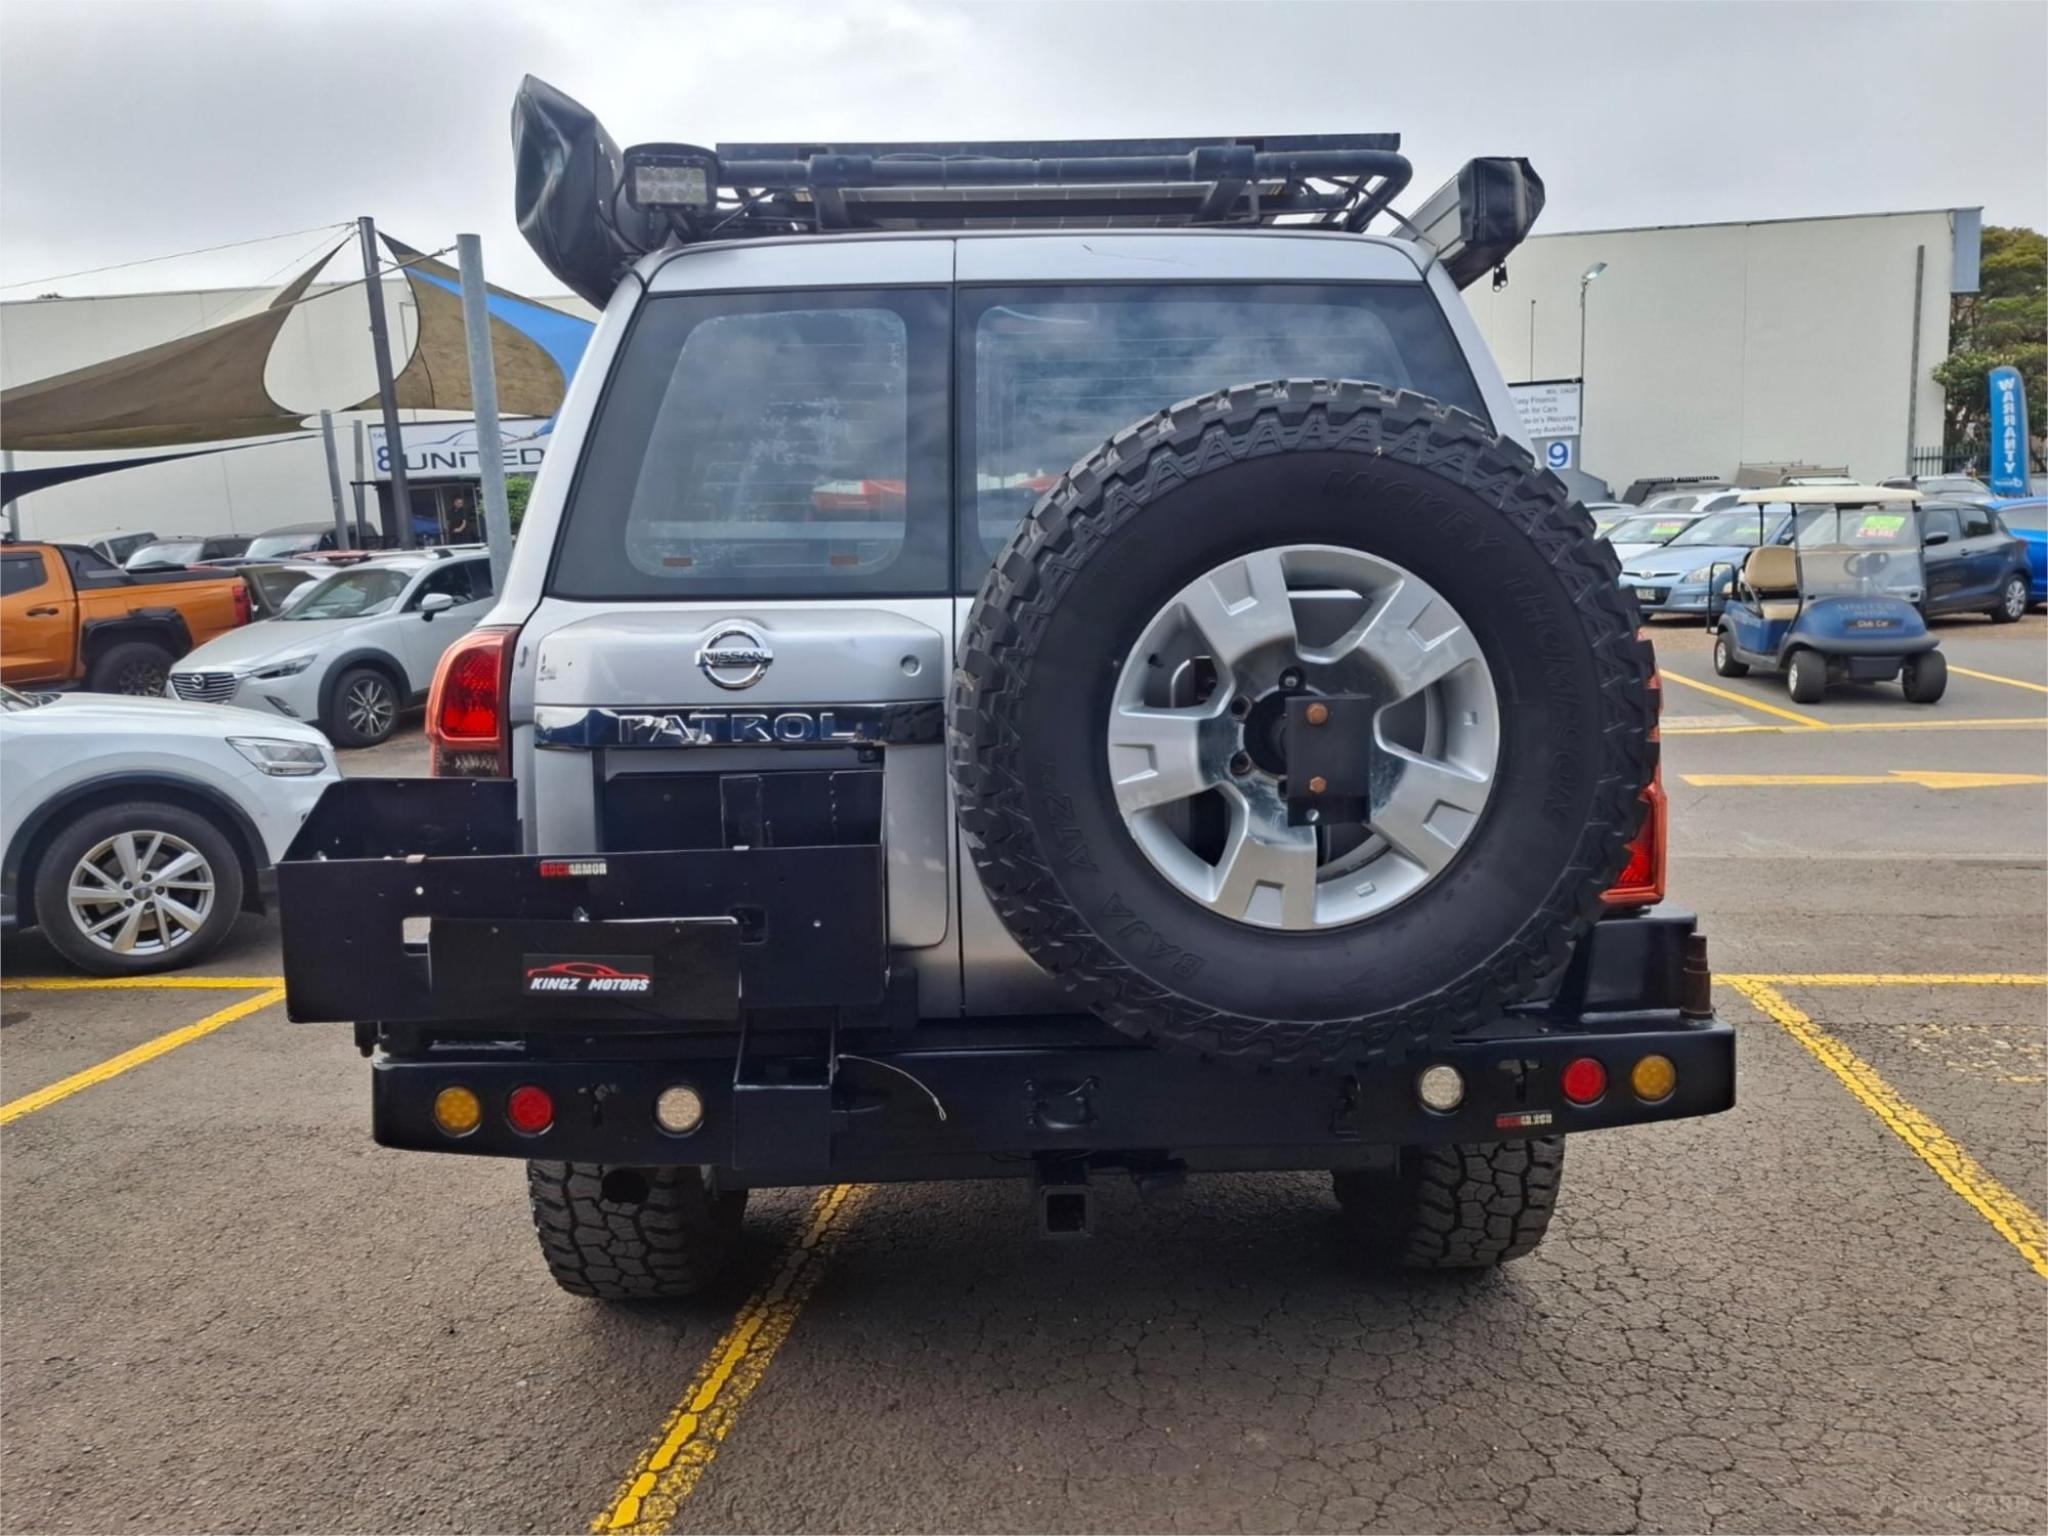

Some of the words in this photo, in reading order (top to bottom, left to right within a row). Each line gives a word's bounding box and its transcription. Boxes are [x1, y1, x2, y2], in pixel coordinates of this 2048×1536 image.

[1542, 405, 1558, 413] Cars
[1548, 441, 1569, 468] 9
[1876, 619, 1889, 628] Car
[704, 650, 765, 664] NISSAN
[617, 712, 856, 744] PATROL
[1099, 890, 1206, 979] BAJA
[530, 977, 581, 991] KINGZ
[588, 978, 650, 991] MOTORS
